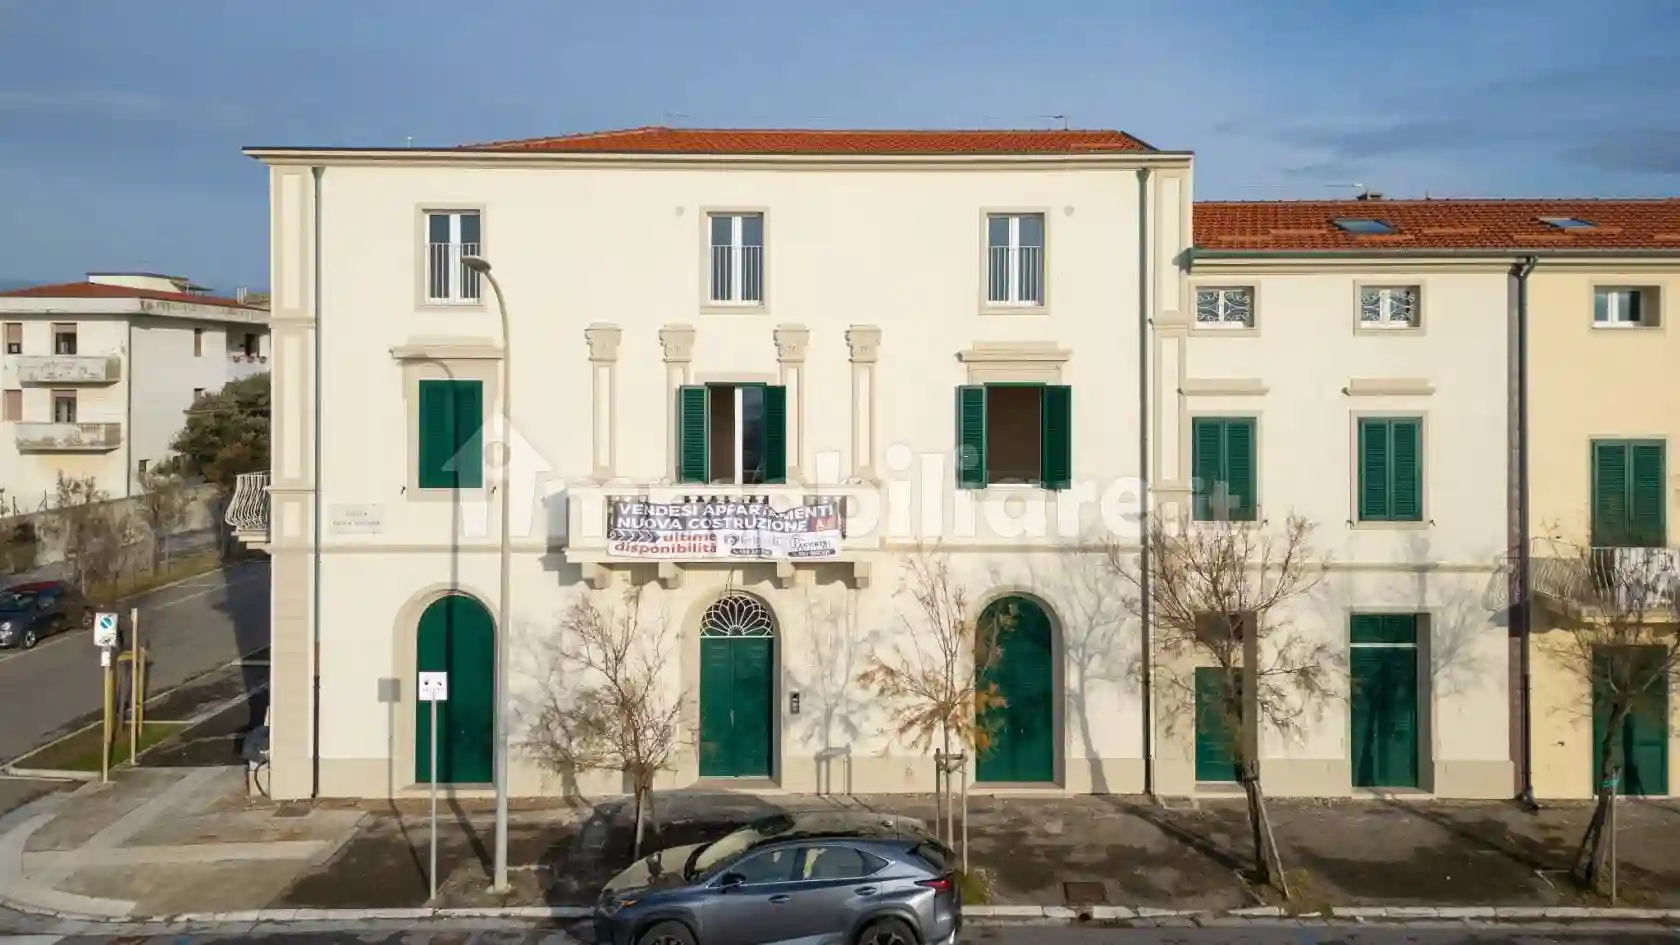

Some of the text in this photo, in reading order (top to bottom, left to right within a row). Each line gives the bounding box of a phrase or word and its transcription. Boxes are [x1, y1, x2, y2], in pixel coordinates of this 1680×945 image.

[618, 503, 833, 521] VENDESI APPARTAMENTI
[616, 516, 682, 530] NUOVA
[687, 517, 808, 533] COSTRUZIONE
[662, 531, 717, 542] ultime
[614, 541, 717, 555] disponibilità
